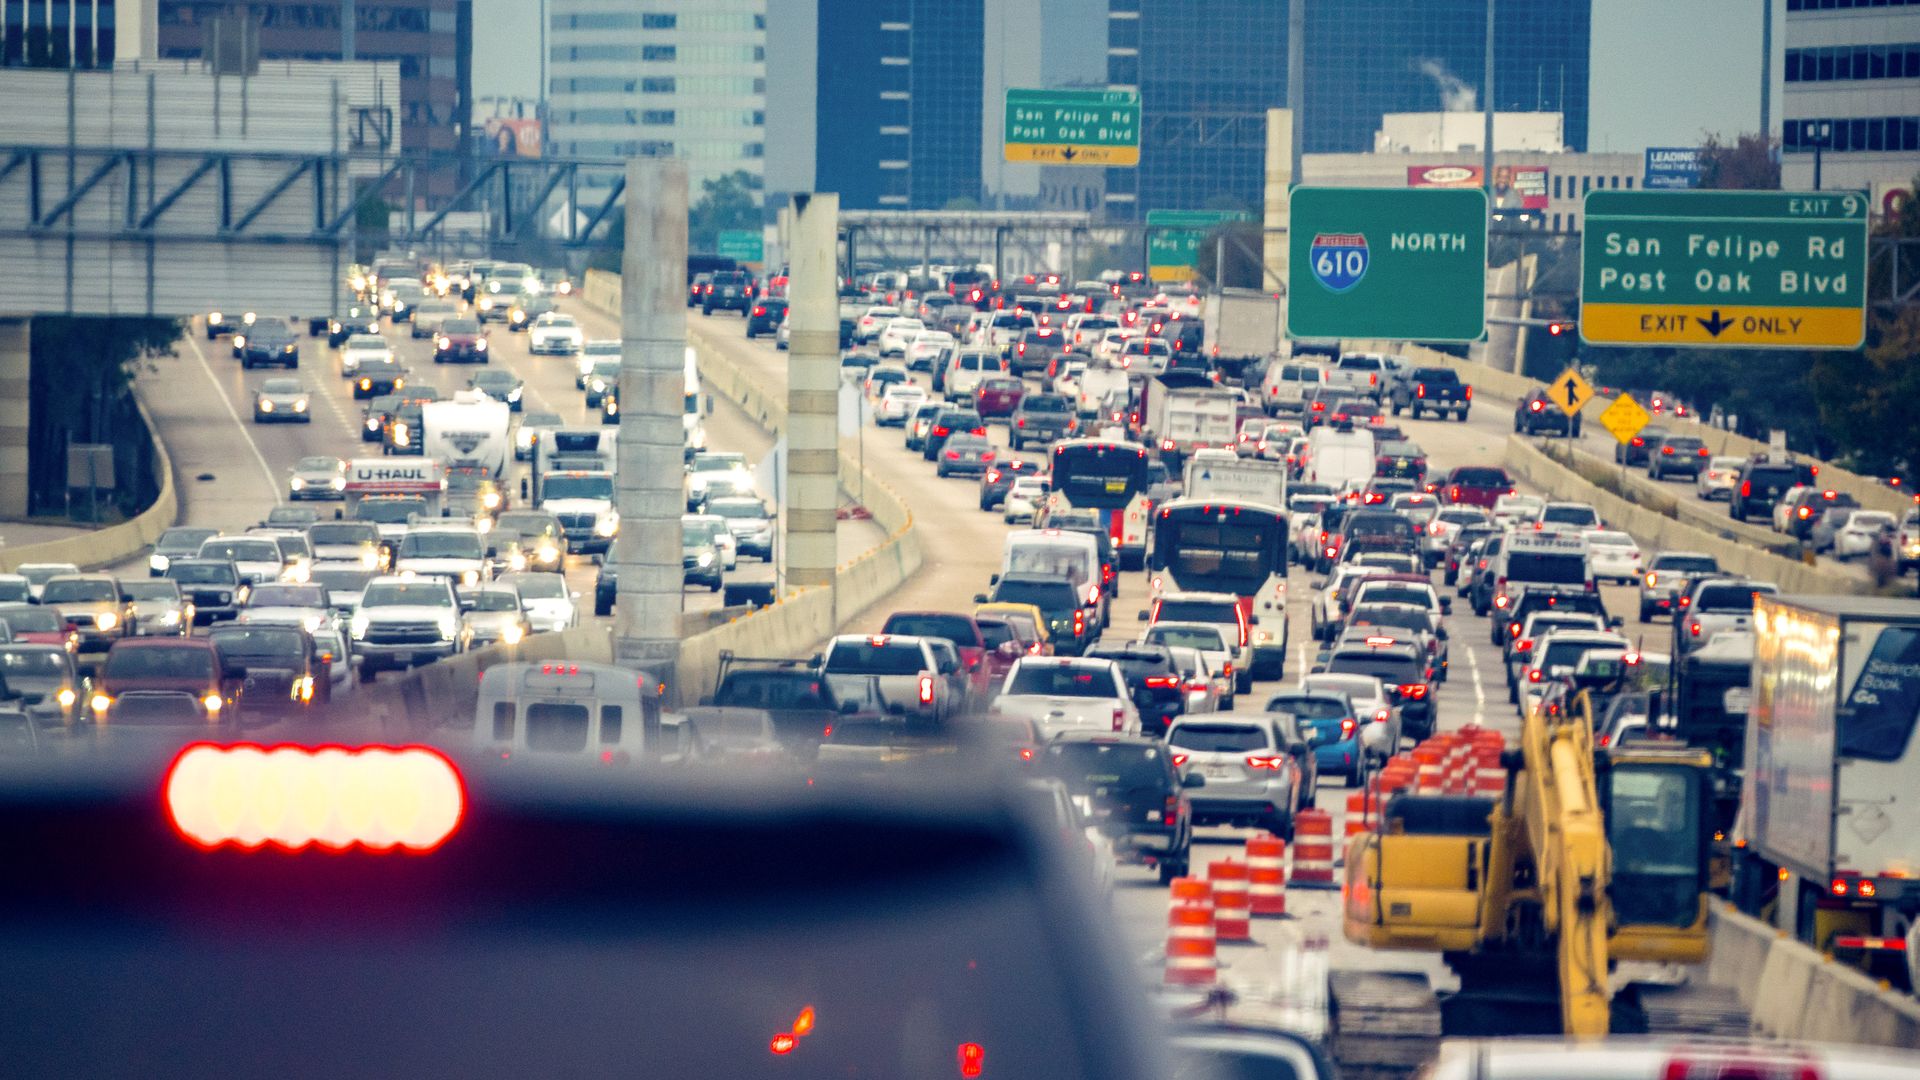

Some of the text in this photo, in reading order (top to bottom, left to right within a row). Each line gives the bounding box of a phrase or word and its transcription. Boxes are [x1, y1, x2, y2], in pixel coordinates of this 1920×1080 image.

[1015, 108, 1131, 125] San Felipe Rd
[1013, 126, 1132, 140] Post Oak Blvd
[1650, 151, 1697, 162] LEADING
[1789, 195, 1858, 217] EXIT 9
[1391, 232, 1466, 252] NORTH
[1605, 233, 1846, 263] San Felipe Rd
[1316, 250, 1364, 277] 610
[1600, 267, 1848, 294] Post Oak Blvd
[1640, 314, 1803, 335] EXIT ONLY
[358, 469, 427, 480] U-HAUL
[1853, 689, 1880, 705] Go.
